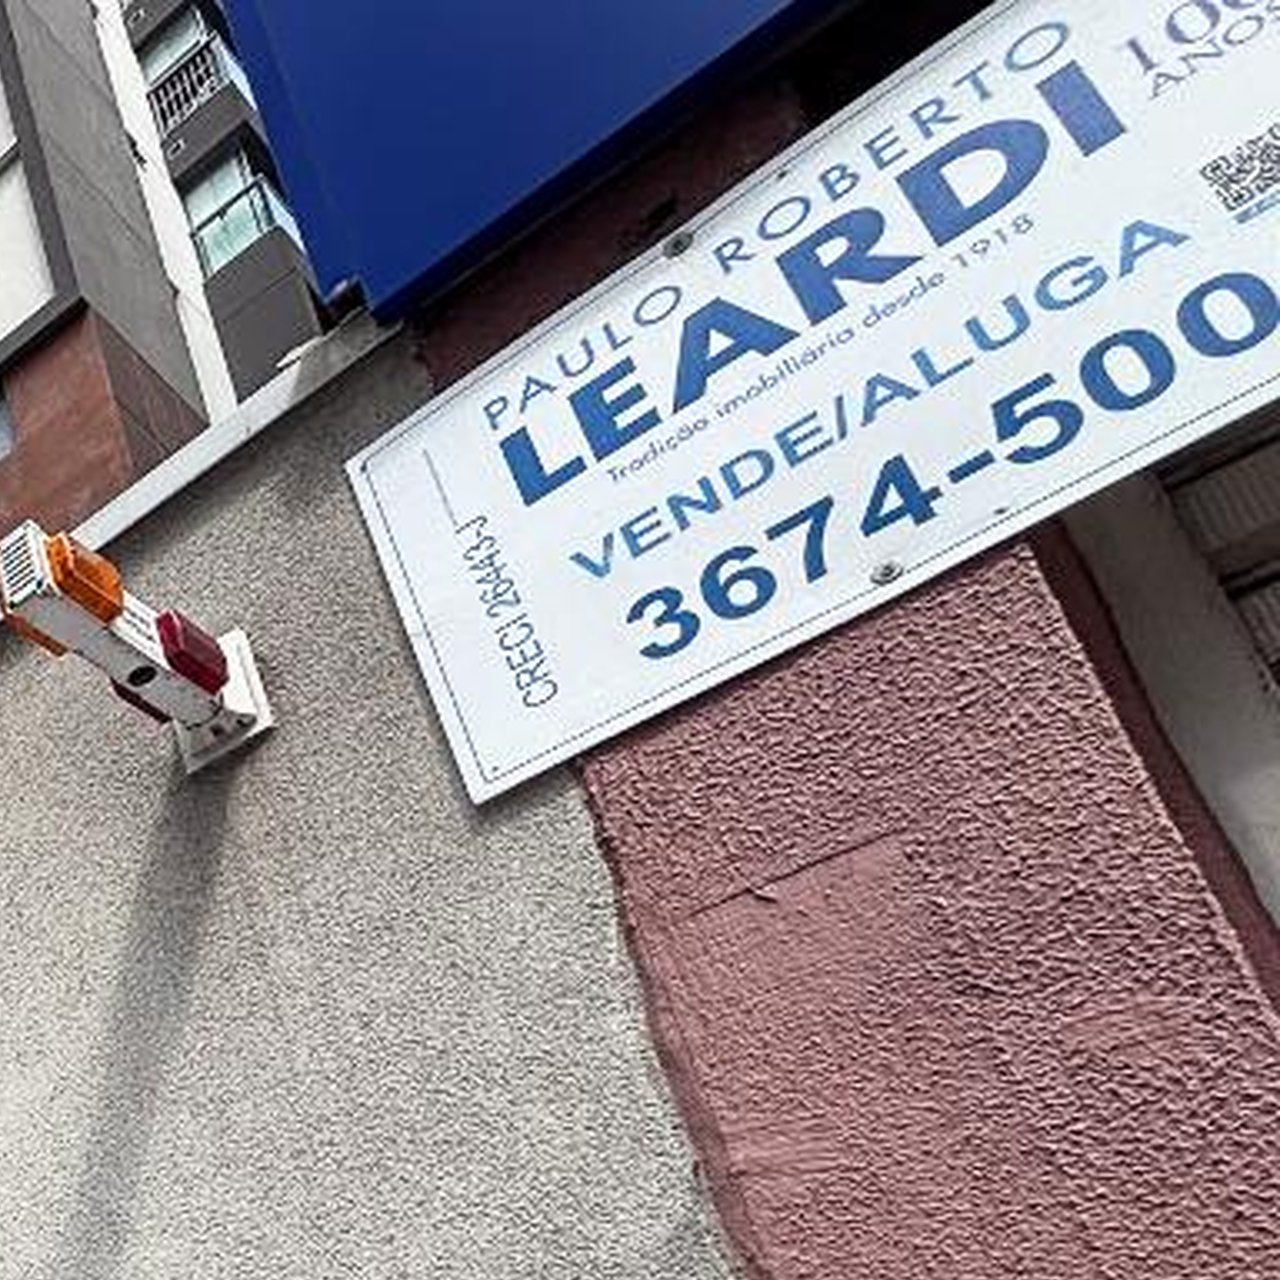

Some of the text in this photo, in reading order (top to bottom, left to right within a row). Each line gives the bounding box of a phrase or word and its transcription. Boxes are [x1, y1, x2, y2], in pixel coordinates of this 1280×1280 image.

[1127, 0, 1257, 76] 10
[483, 22, 1070, 431] PAULO ROBERTO
[499, 60, 1127, 507] LEARDI
[570, 219, 1190, 579] VENDE/ALUGA
[607, 414, 709, 483] Tradição
[861, 267, 946, 329] desde
[950, 213, 1036, 269] 1918
[625, 272, 1280, 661] 3674-500
[495, 612, 559, 707] CRECI
